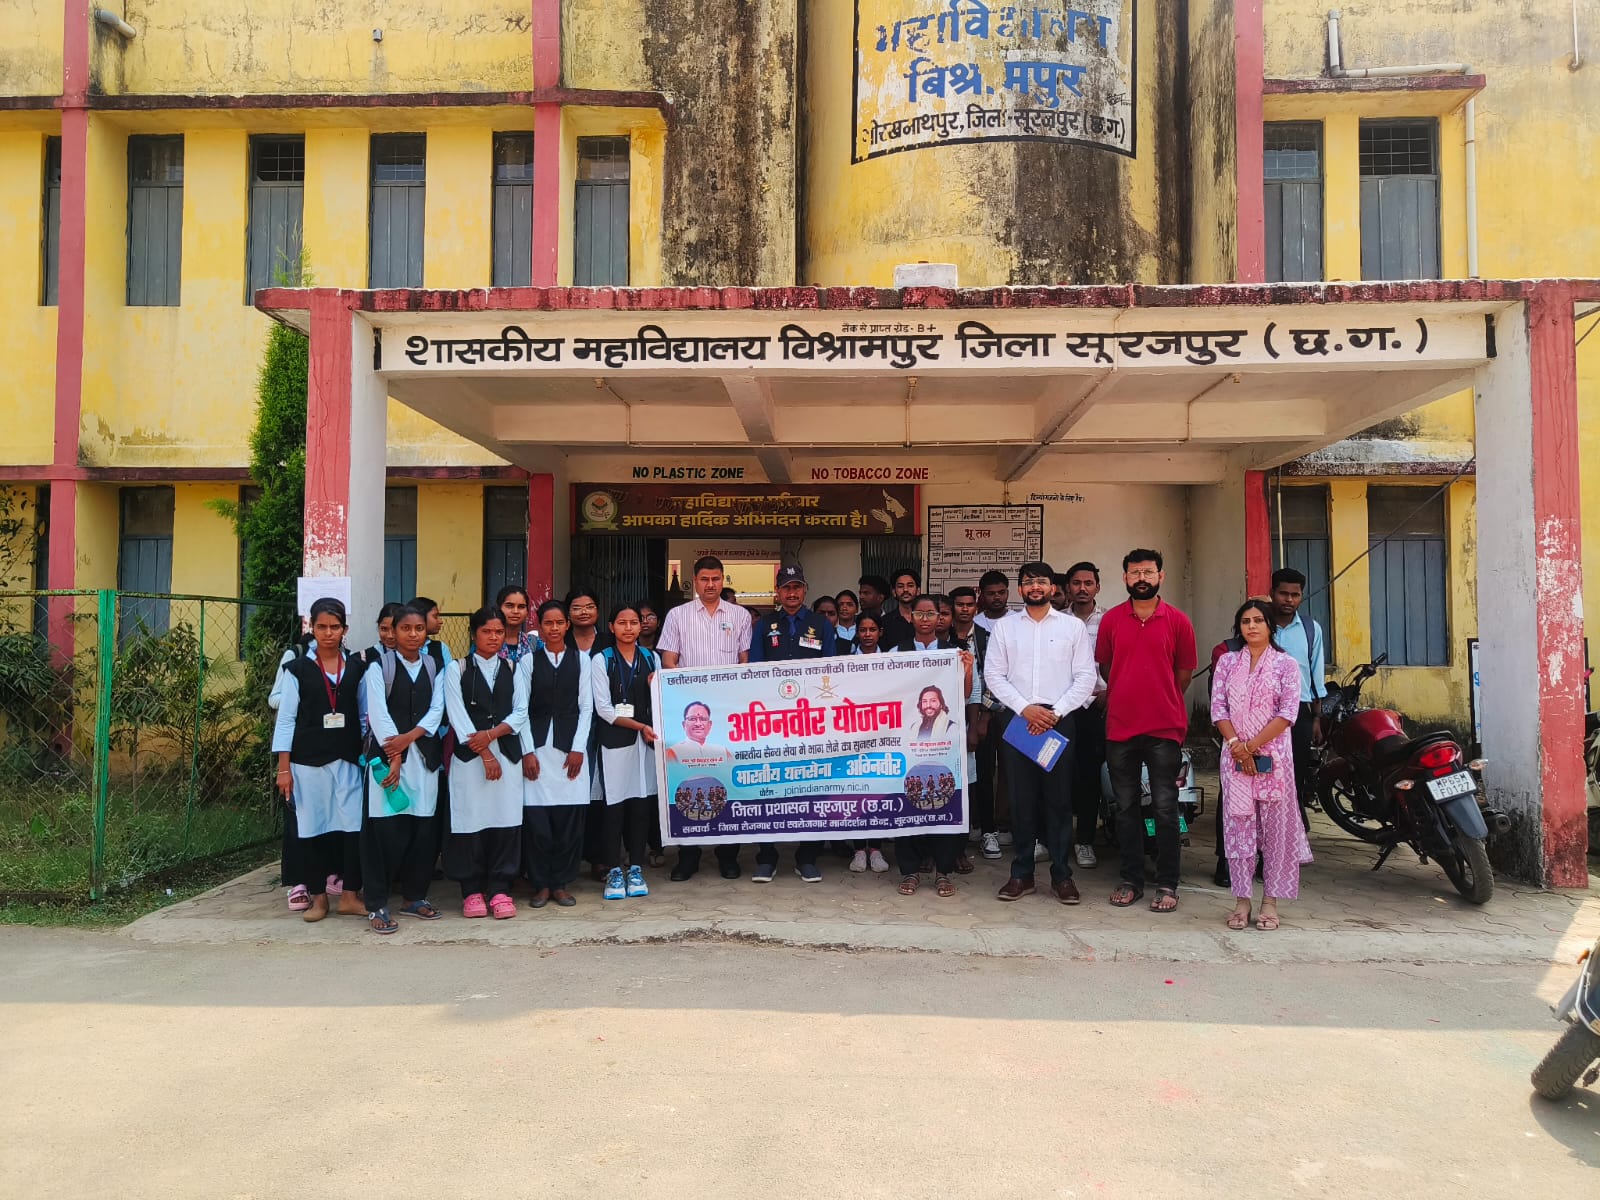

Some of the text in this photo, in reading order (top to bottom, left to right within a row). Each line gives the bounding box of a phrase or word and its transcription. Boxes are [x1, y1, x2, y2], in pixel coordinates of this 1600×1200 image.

[405, 325, 565, 366] शासकीय
[573, 324, 771, 368] महाविद्यालय
[778, 323, 943, 368] विश्रामपुर
[955, 320, 1056, 359] जिला
[1066, 330, 1248, 366] सूरजपुर
[632, 466, 744, 479] NO PLASTIC ZONE
[811, 467, 929, 479] NO TOBACCO ZONE
[622, 514, 677, 527] आपका
[680, 511, 730, 527] हार्दिक
[733, 510, 801, 527] अभिनंदन
[804, 514, 847, 526] करता
[975, 529, 991, 538] तल
[711, 672, 738, 682] शासन
[741, 668, 770, 680] कौशल
[772, 666, 802, 678] विकास
[804, 662, 845, 676] तकनीकी
[847, 661, 869, 673] शिक्षा
[887, 659, 920, 670] रोजगार
[922, 657, 951, 668] विभाग
[727, 697, 902, 743] अग्निवीर योजना
[735, 747, 762, 761] भारतीय
[764, 745, 781, 759] सैन्य
[783, 743, 797, 757] सेवा
[808, 743, 824, 755] भाग
[841, 741, 851, 752] का
[879, 737, 902, 747] अवसर
[736, 763, 781, 785] भारतीय
[784, 761, 832, 781] थलसेना
[846, 753, 902, 776] अग्निवीर
[784, 782, 870, 797] joinindianarmy.nic.in
[731, 797, 904, 817] जिला प्रशासन सूरजपुर (छ.ग.)
[718, 822, 739, 831] जिला
[741, 820, 771, 831] रोजगार
[829, 816, 867, 828] मार्गदर्शन
